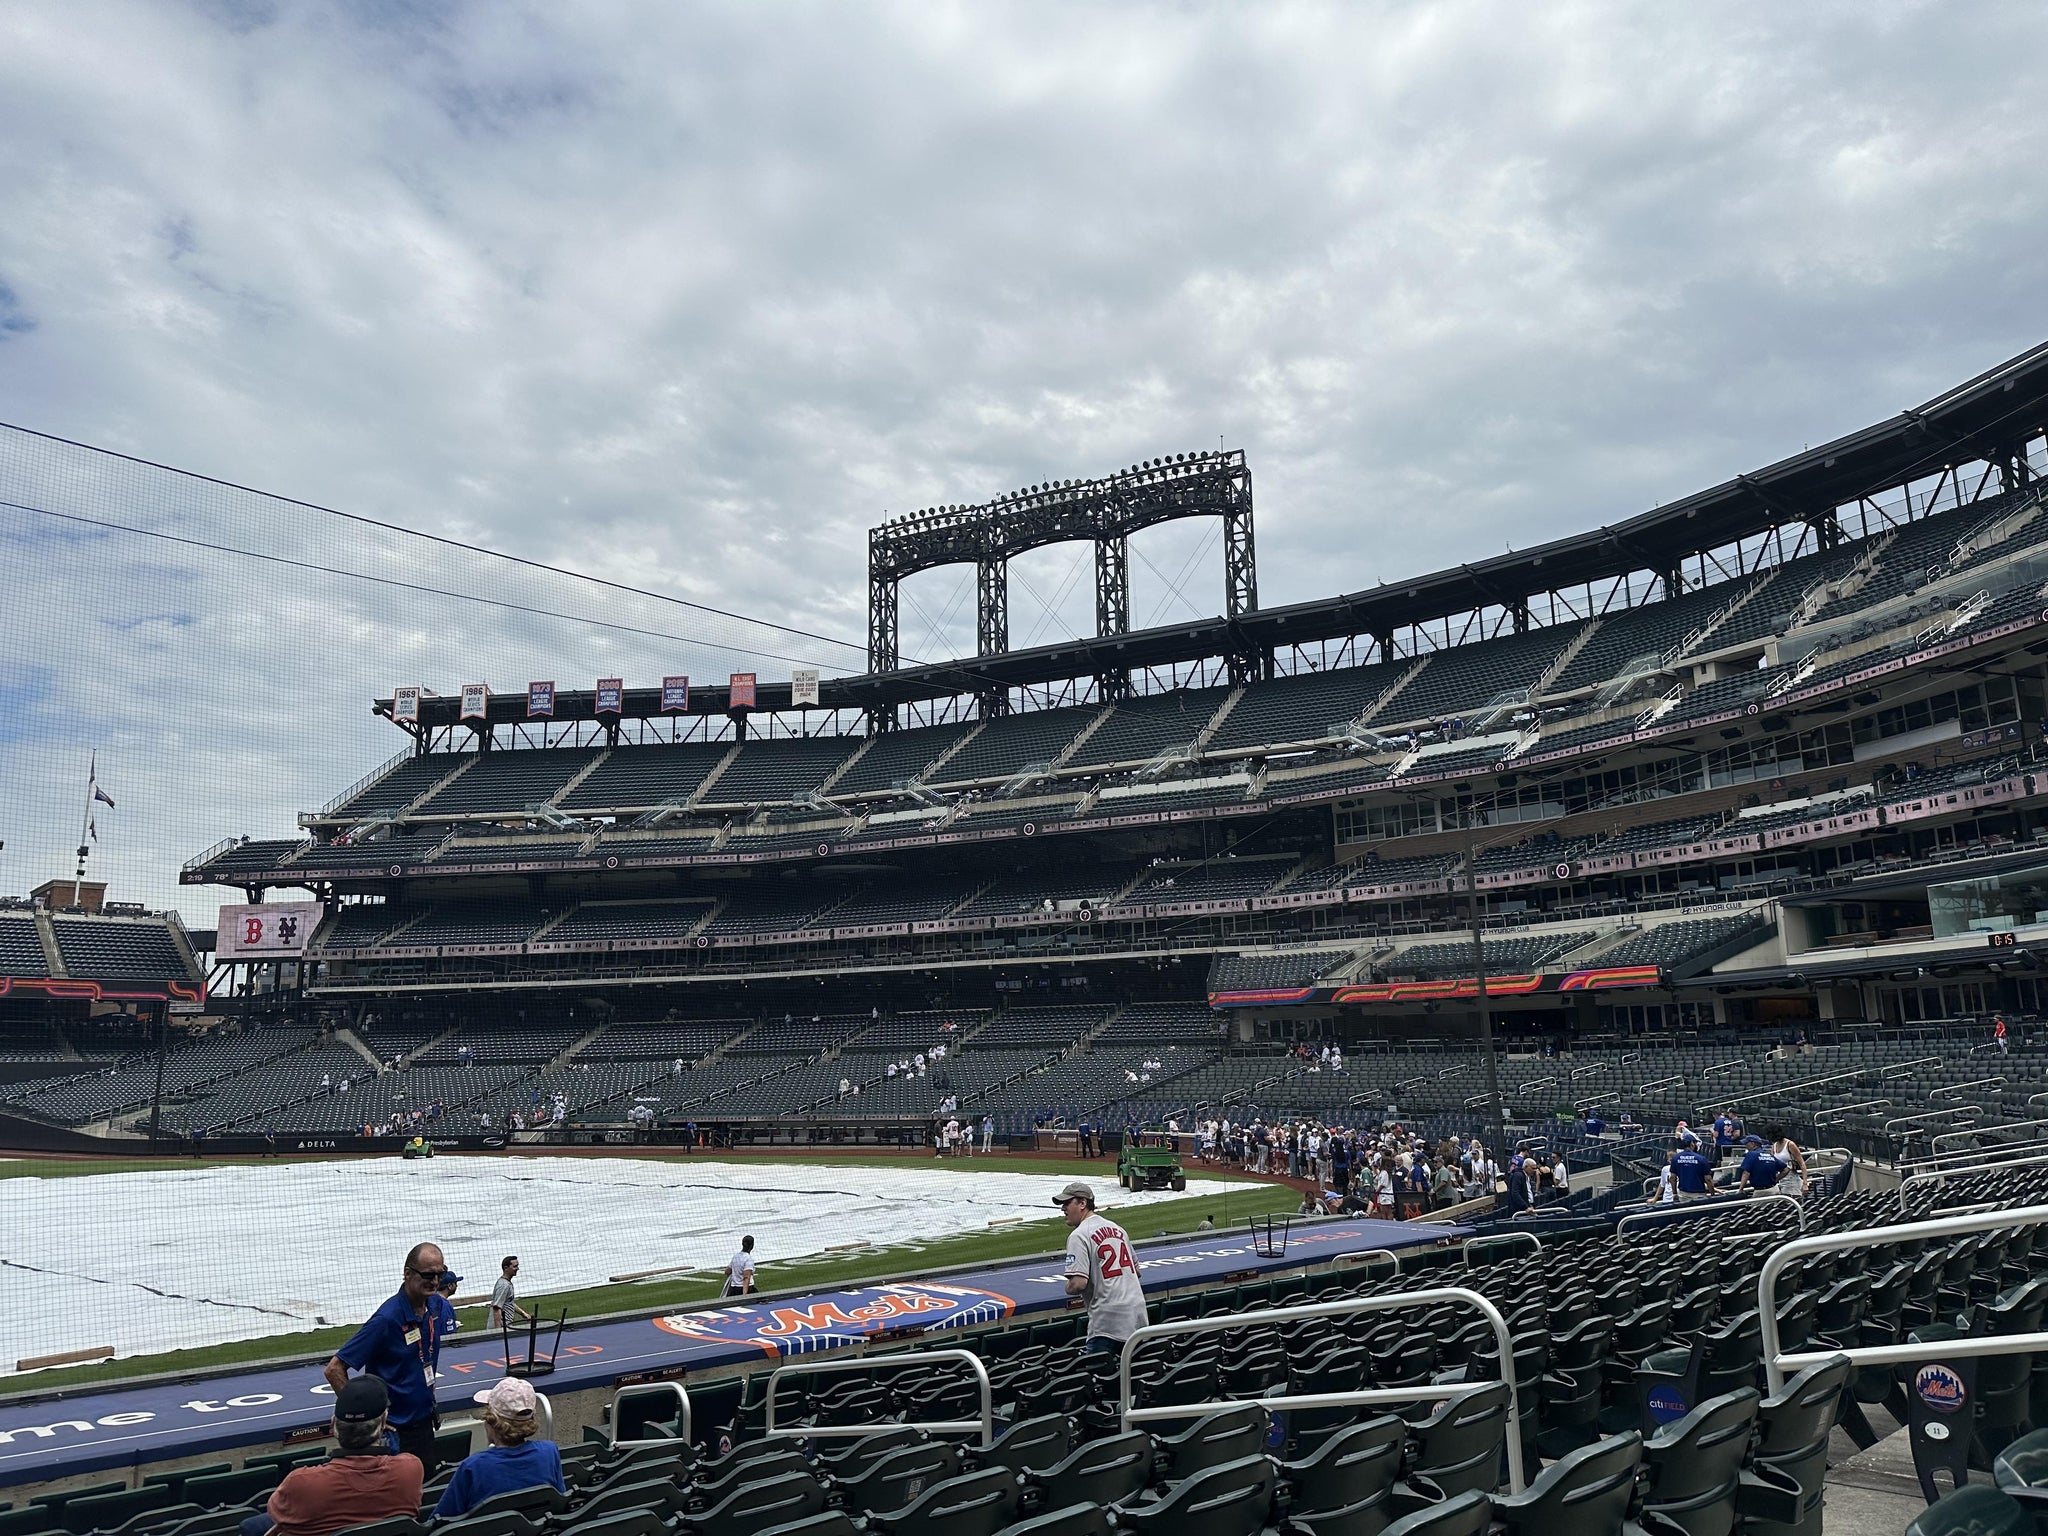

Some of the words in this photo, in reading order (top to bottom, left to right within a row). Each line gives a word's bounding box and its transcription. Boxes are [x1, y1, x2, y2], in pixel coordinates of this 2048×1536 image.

[398, 690, 416, 699] 1969
[466, 687, 483, 696] 1986
[1693, 904, 1724, 913] HYUNDAI
[244, 918, 263, 944] B
[307, 1140, 335, 1148] DELTA
[1097, 1242, 1135, 1279] 24
[756, 1293, 959, 1337] Mets
[450, 1345, 604, 1374] FIELD
[1922, 1380, 1957, 1398] Mets
[180, 1393, 284, 1412] to
[292, 1427, 320, 1437] CAUTION!
[1933, 1427, 1940, 1435] 11
